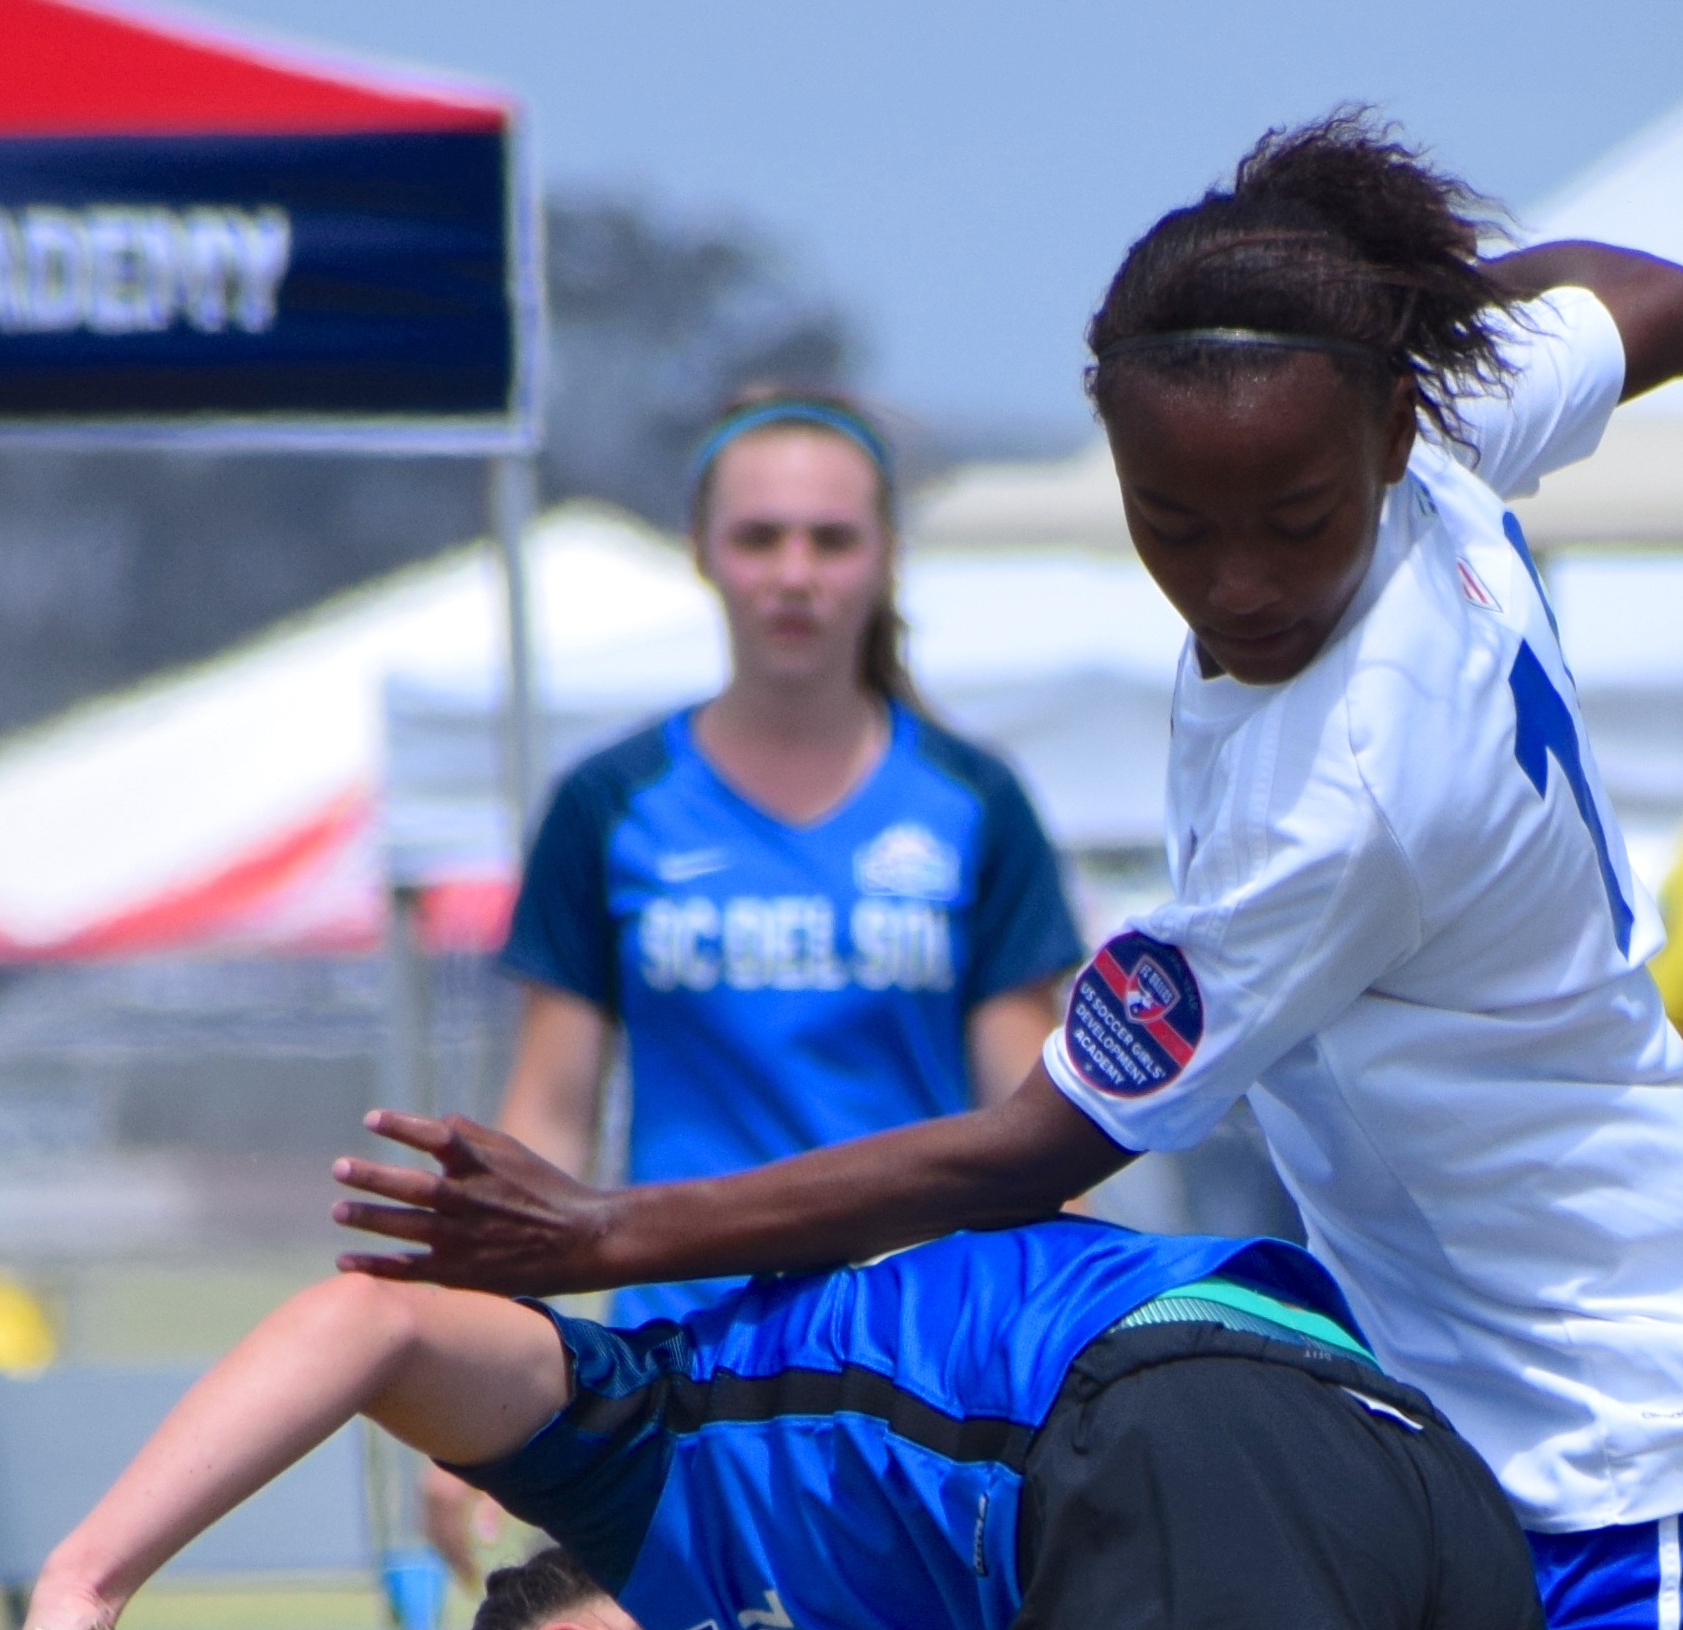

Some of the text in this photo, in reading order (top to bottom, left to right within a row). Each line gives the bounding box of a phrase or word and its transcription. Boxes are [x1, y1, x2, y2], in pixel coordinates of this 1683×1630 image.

[724, 893, 849, 991] DEL
[1074, 1028, 1125, 1084] ACADEMY
[1075, 1002, 1148, 1085] DEVELOPMENT
[1092, 998, 1134, 1046] SOCCER
